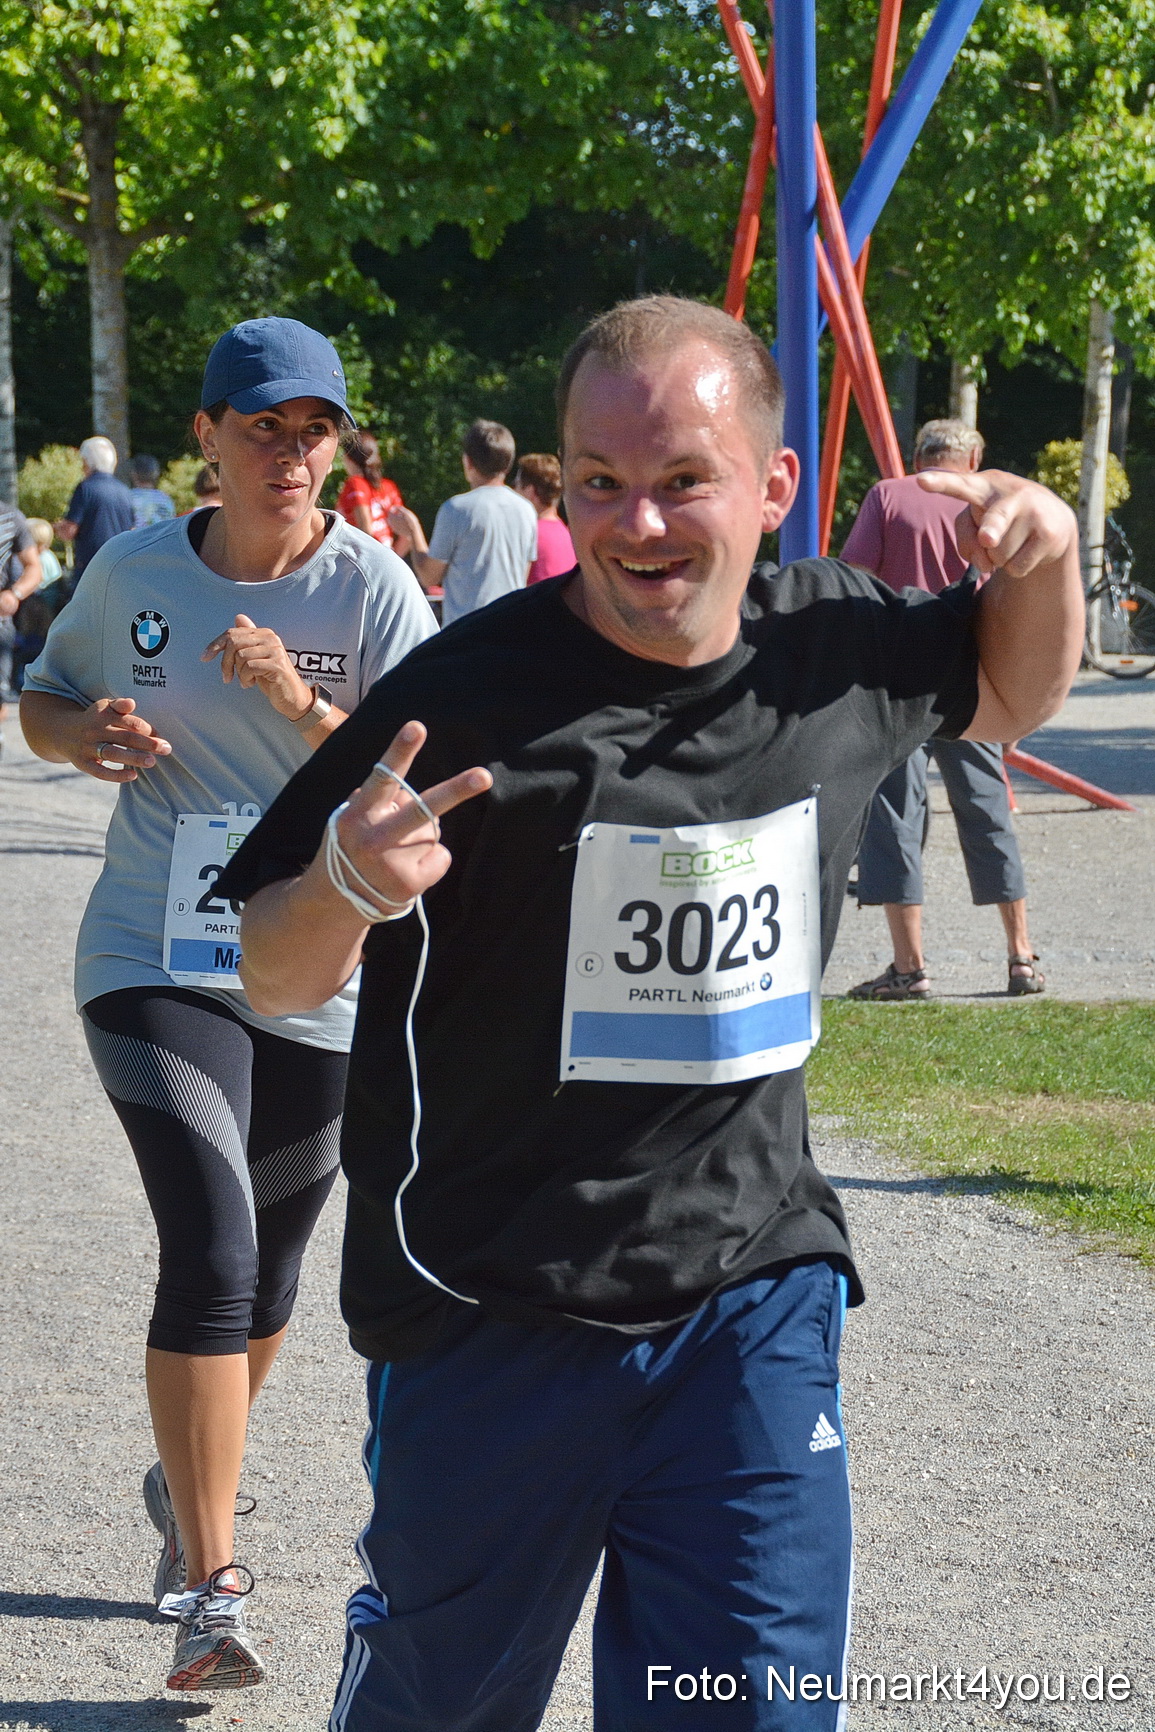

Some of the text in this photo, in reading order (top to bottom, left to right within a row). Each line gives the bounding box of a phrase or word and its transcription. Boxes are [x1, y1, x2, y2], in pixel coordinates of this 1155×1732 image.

[285, 649, 348, 675] CK
[132, 664, 167, 679] PARTL
[314, 675, 347, 684] concepts
[133, 677, 166, 688] Neumarkt
[661, 838, 755, 877] BOCK
[204, 923, 241, 936] PARTL
[613, 884, 781, 976] 3023
[628, 981, 756, 1003] PARTL Neumarkt
[809, 1434, 842, 1452] adidas
